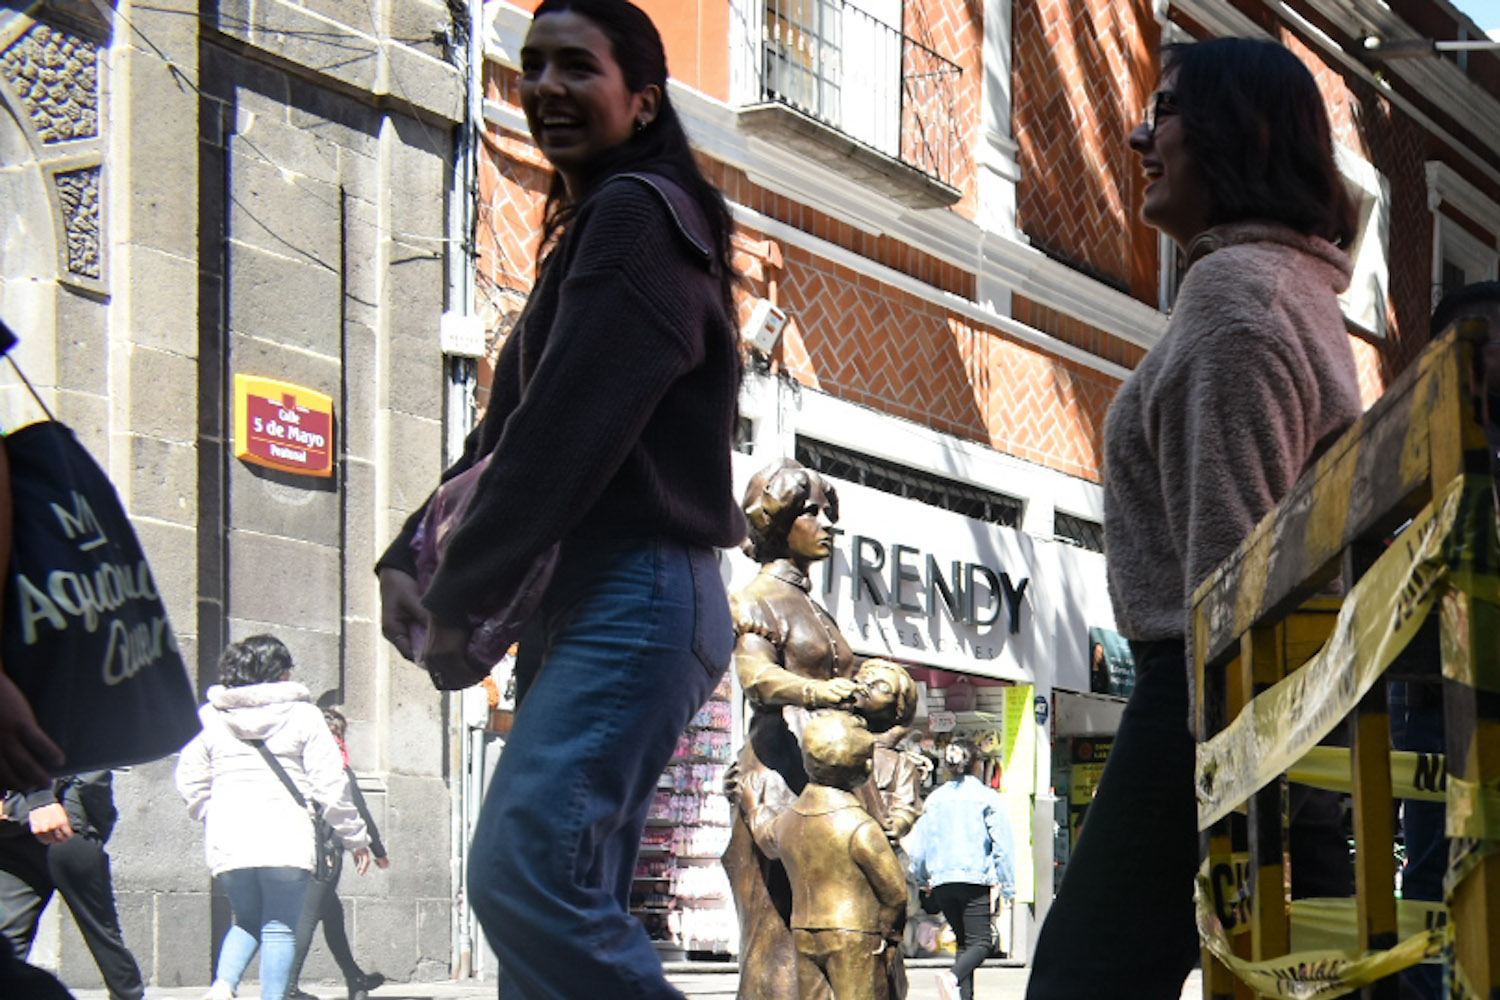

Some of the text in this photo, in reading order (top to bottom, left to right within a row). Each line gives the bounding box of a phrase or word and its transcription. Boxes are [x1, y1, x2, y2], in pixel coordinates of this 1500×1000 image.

[252, 416, 325, 448] 5 de Mayo
[821, 525, 1029, 635] TRENDY
[848, 622, 995, 662] ACCESOES
